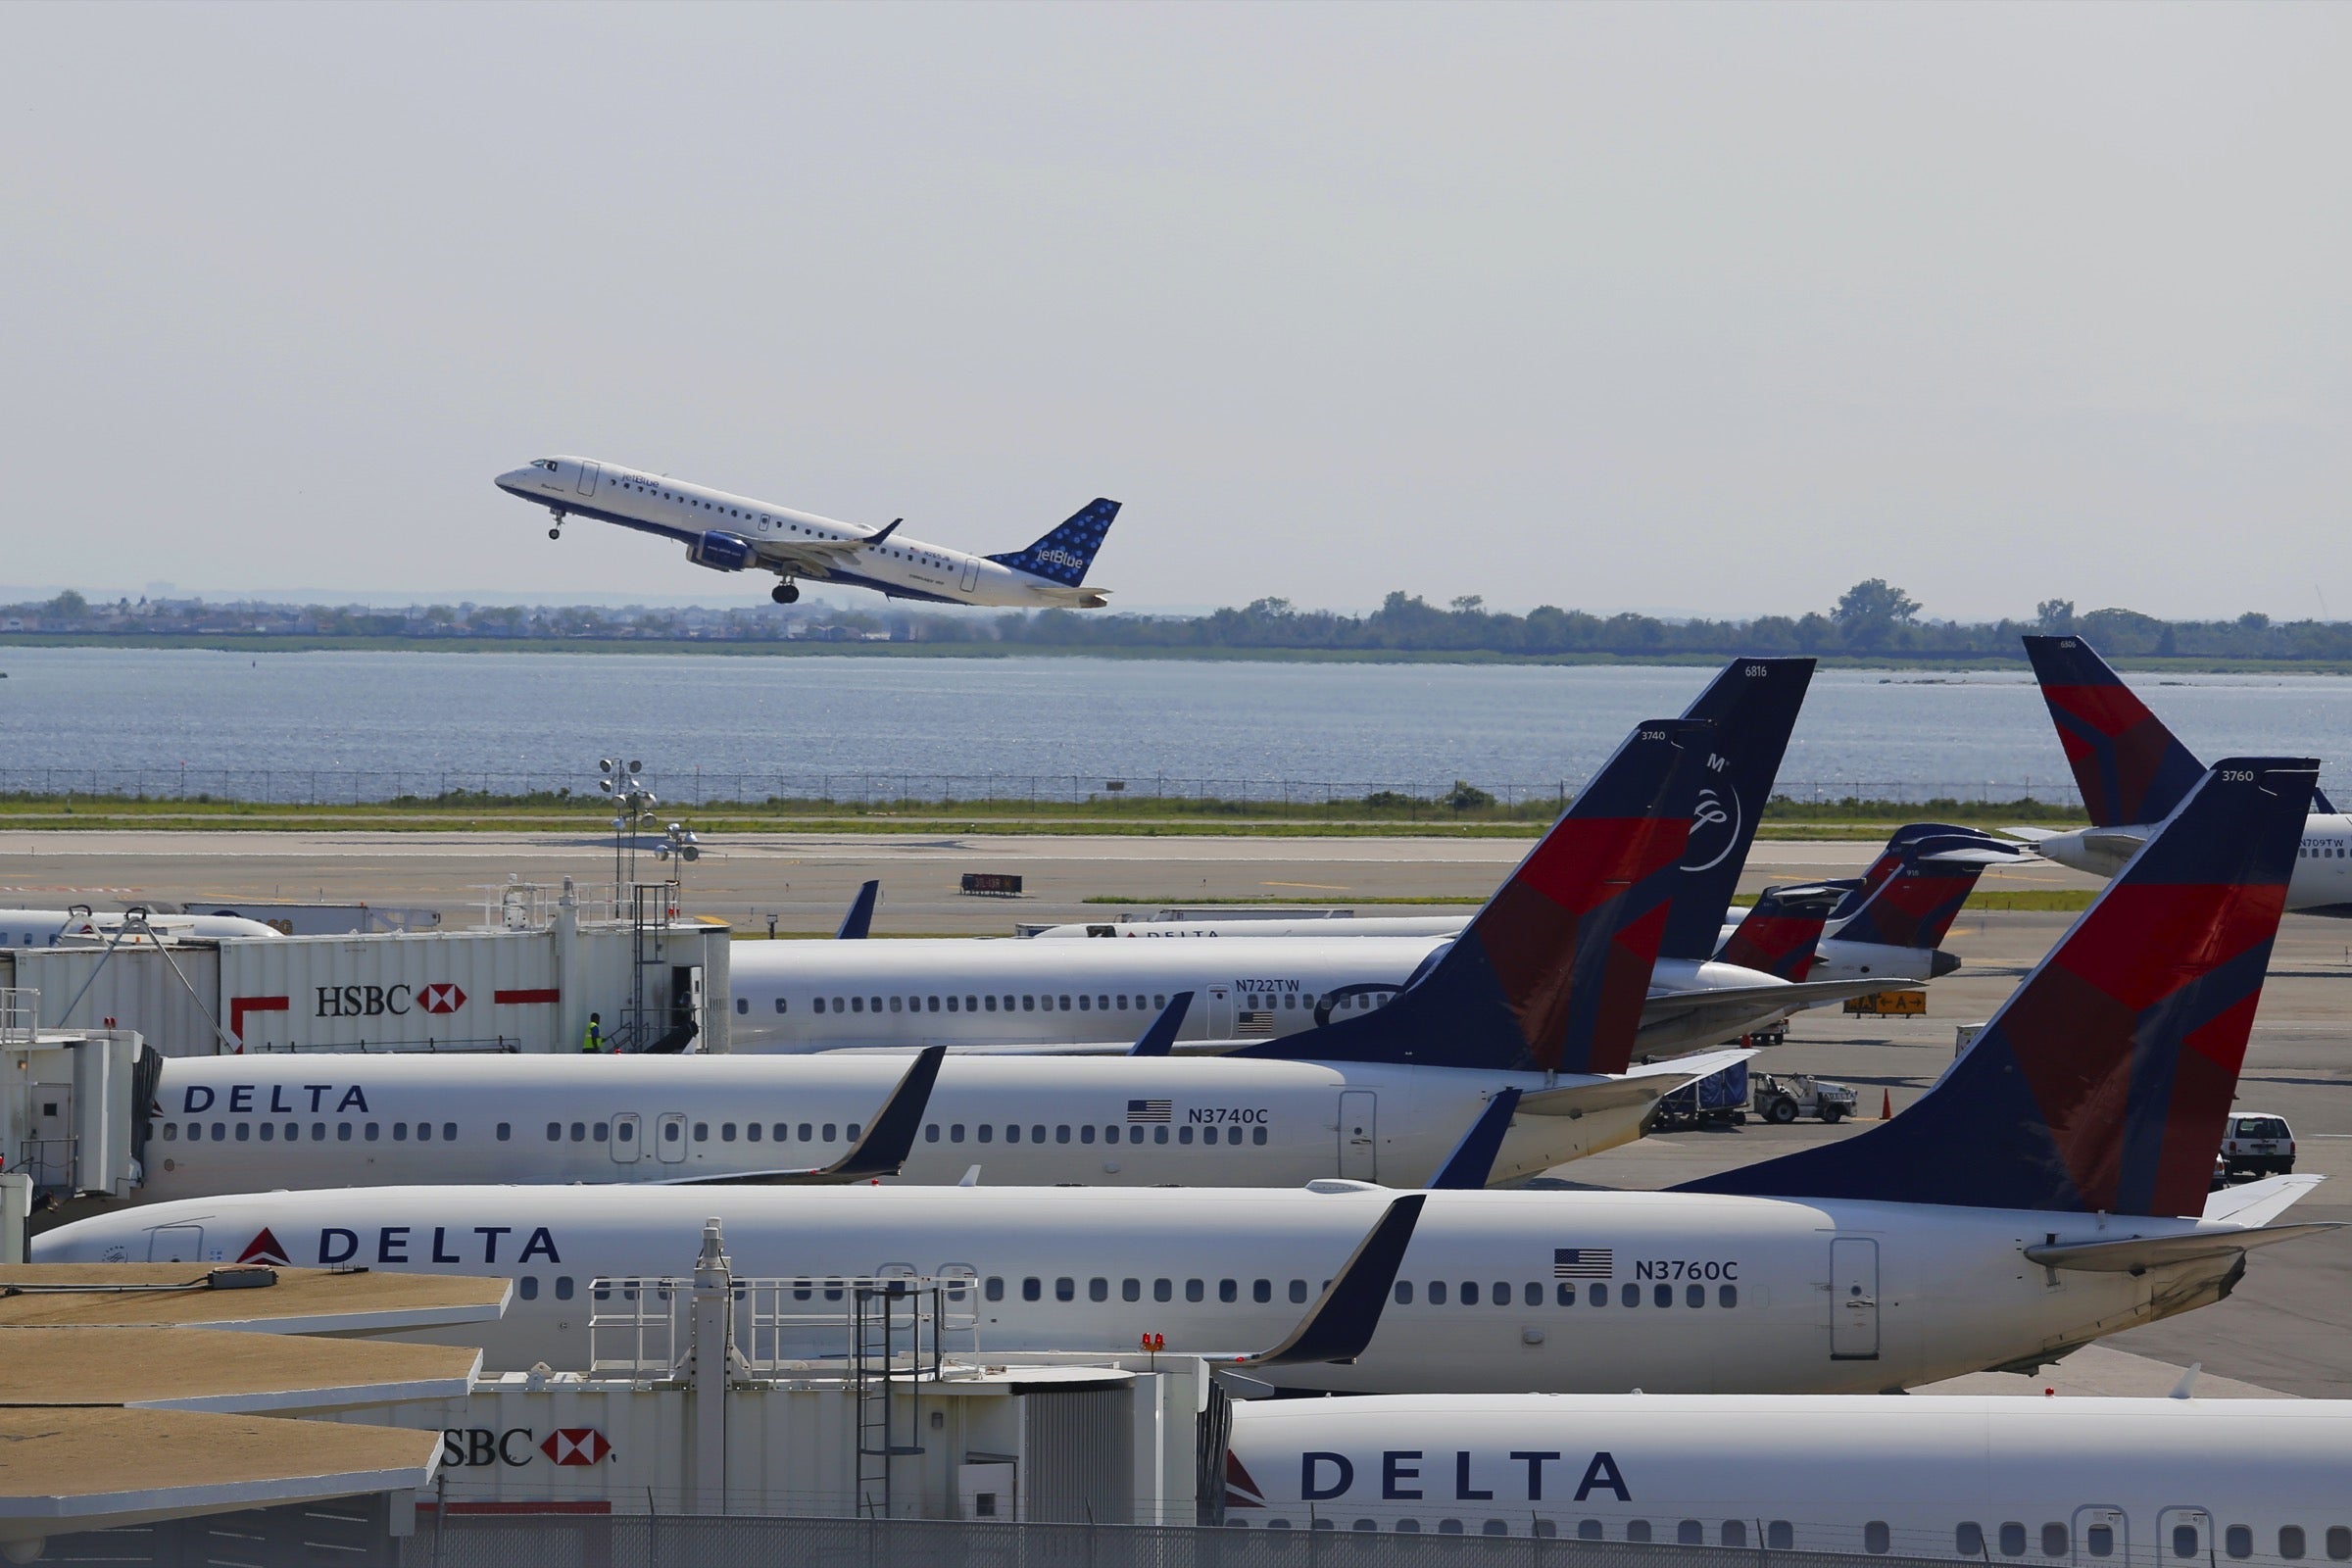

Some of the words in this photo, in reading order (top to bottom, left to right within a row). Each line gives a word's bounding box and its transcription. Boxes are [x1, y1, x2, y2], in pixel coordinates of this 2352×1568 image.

[1036, 546, 1083, 568] jetBlue
[1744, 665, 1767, 677] 6816
[1641, 730, 1666, 741] 3740
[2222, 769, 2254, 782] 3760
[1236, 979, 1299, 993] N722TW
[316, 984, 411, 1017] HSBC
[1895, 995, 1907, 1010] A
[183, 1084, 369, 1113] DELTA
[1188, 1108, 1268, 1125] N3740C
[318, 1226, 562, 1263] DELTA
[1635, 1260, 1738, 1281] N3760C
[431, 1428, 534, 1467] SBC
[1300, 1450, 1632, 1501] DELTA
